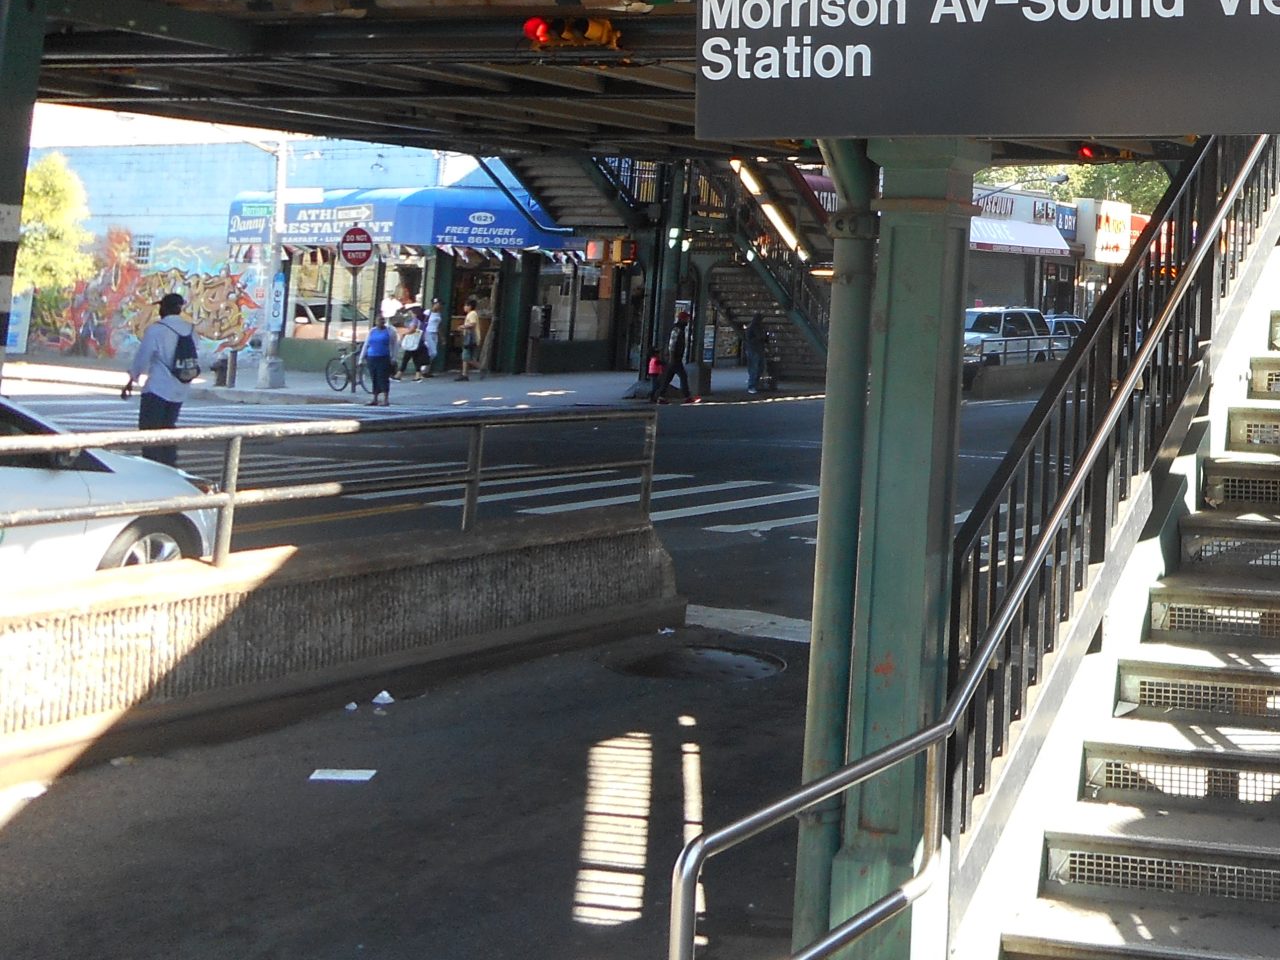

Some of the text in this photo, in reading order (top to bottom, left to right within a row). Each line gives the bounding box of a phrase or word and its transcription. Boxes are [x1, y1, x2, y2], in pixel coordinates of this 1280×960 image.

[701, 36, 872, 81] Station
[281, 221, 393, 234] ESTAUNT
[445, 226, 517, 236] FREE DELIVERY
[346, 234, 367, 242] DO NOT
[436, 235, 464, 244] TEL.
[347, 251, 366, 259] ENTER
